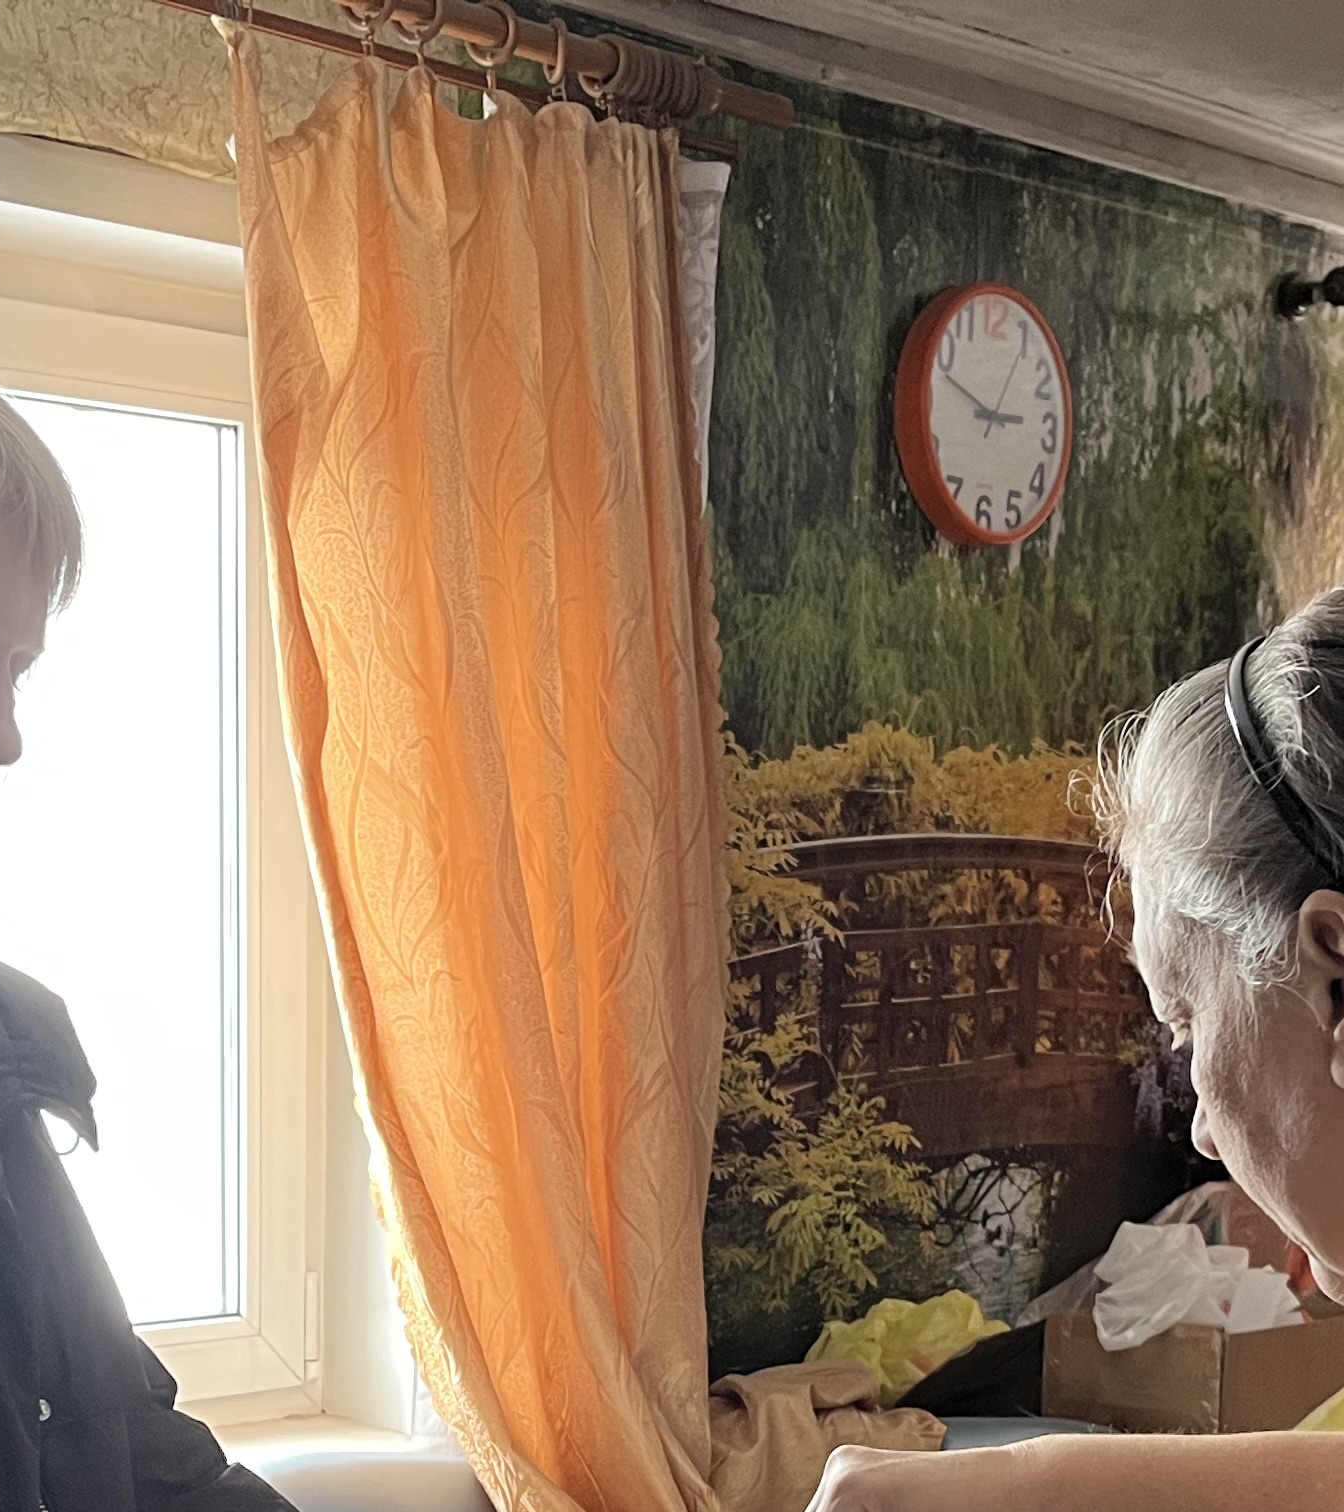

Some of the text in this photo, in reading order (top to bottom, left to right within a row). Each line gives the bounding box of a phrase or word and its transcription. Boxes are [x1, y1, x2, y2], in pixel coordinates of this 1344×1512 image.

[981, 300, 1009, 341] 12
[1017, 319, 1029, 359] 1
[1035, 358, 1052, 400] 2
[1041, 411, 1057, 454] 3
[1029, 462, 1046, 500] 4
[975, 494, 993, 530] 6
[1005, 489, 1022, 530] 5
